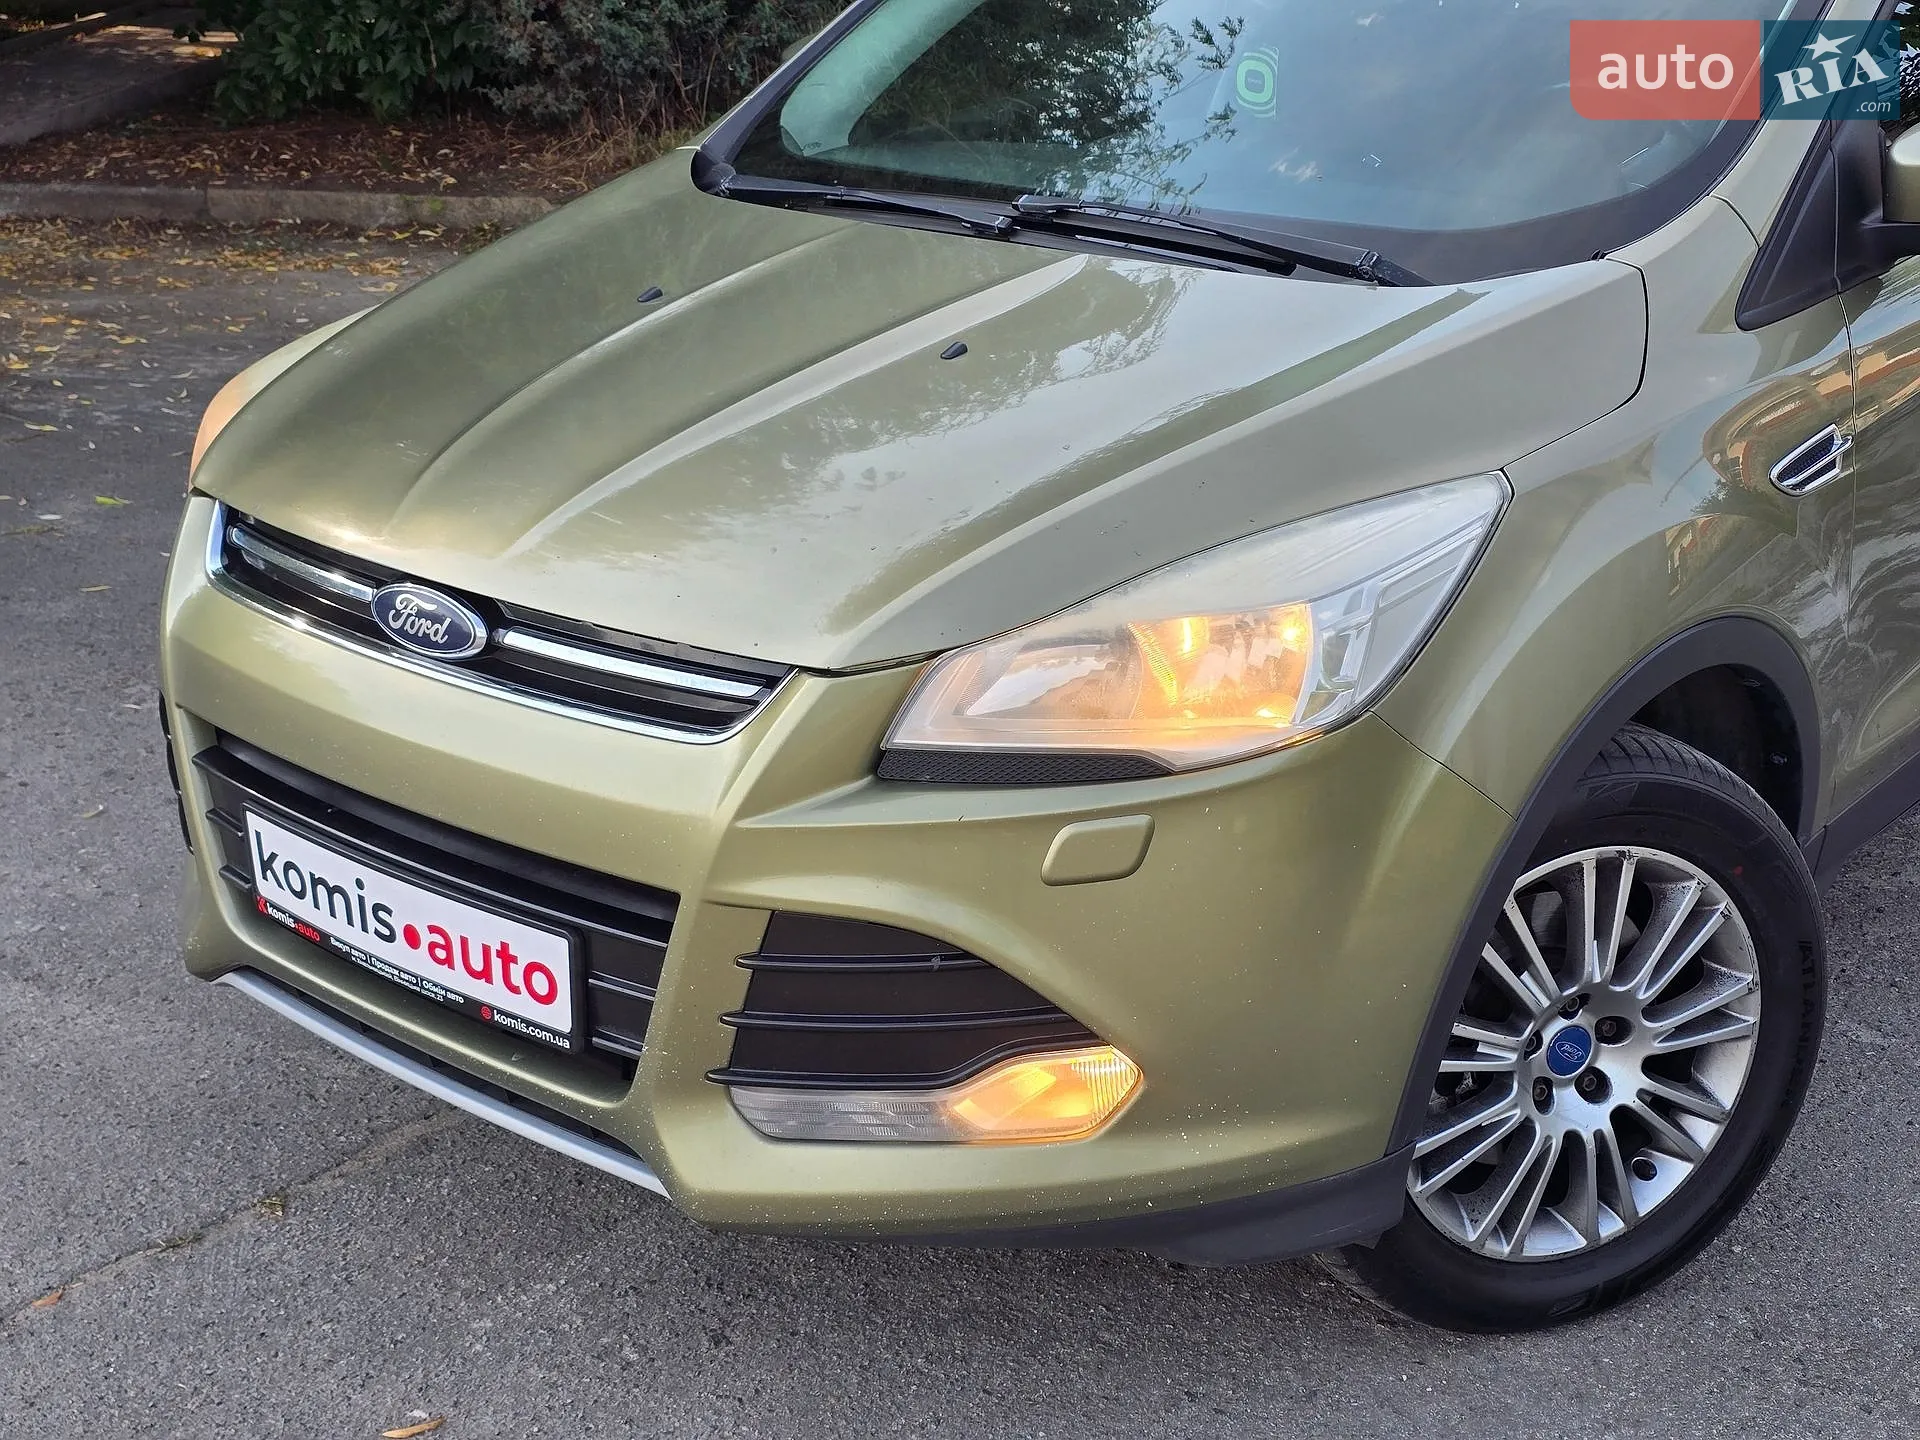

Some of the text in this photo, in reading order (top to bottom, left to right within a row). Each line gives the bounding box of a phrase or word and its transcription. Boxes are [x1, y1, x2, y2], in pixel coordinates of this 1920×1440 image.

[388, 593, 452, 644] Ford
[446, 991, 465, 1004] авто
[494, 1009, 570, 1049] komis.com.ua
